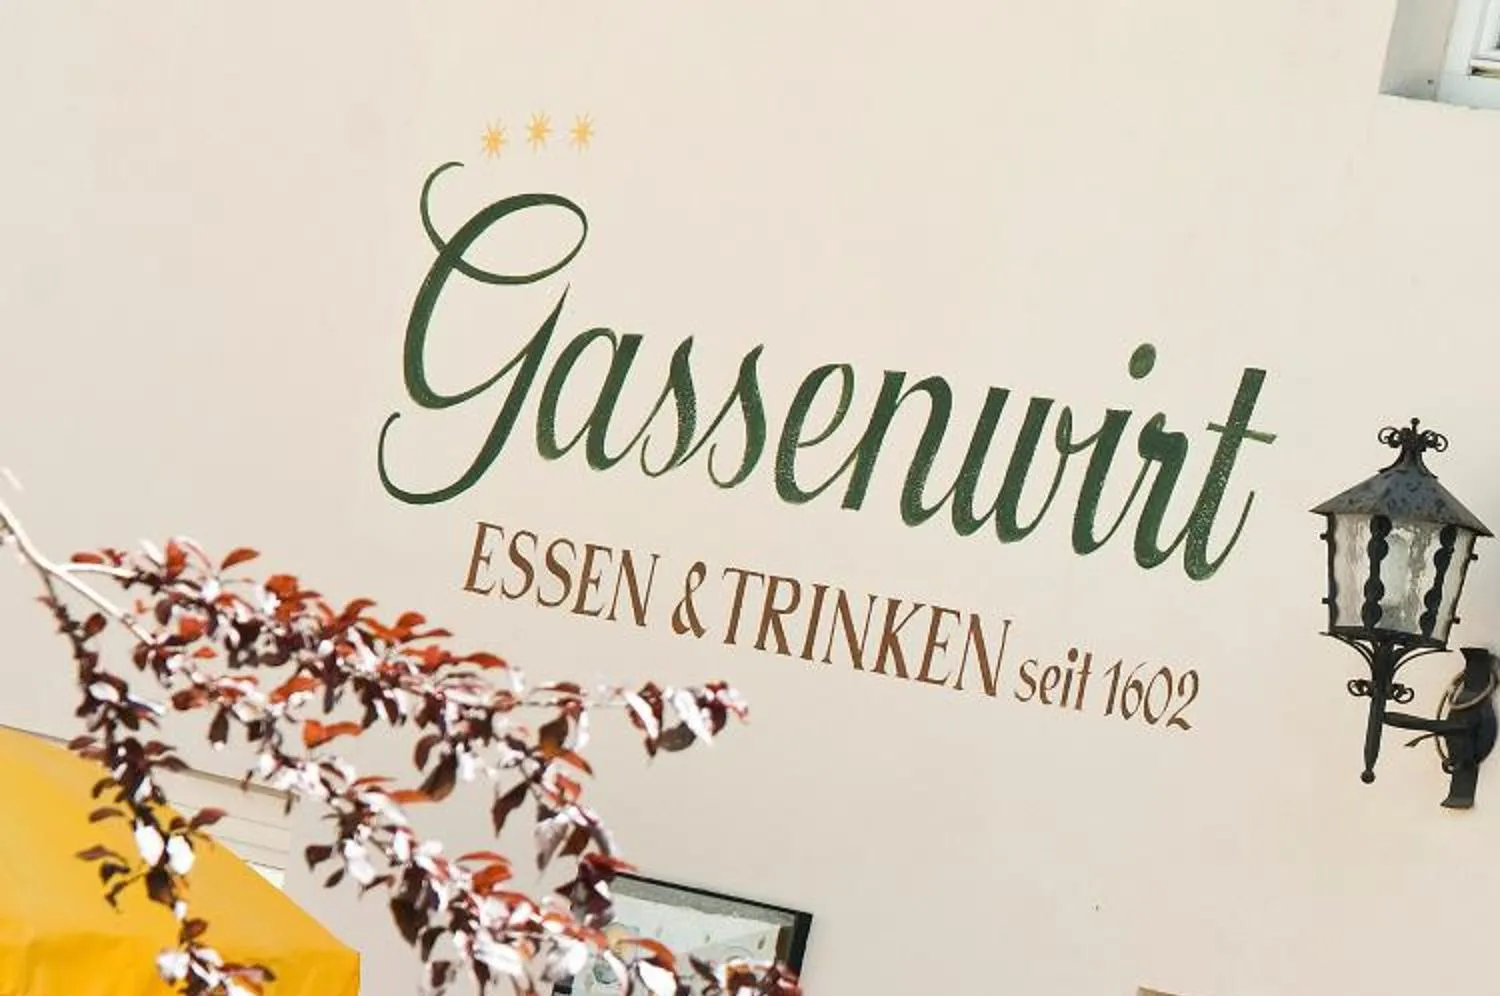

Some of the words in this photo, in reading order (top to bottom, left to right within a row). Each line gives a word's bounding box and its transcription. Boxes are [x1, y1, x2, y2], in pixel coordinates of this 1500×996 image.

[377, 161, 1277, 581] Gassenwirt
[463, 521, 661, 628] ESSEN
[671, 560, 708, 640] &
[721, 567, 1013, 698] TRINKEN
[1013, 647, 1093, 711] seit
[1103, 659, 1200, 732] 1602
